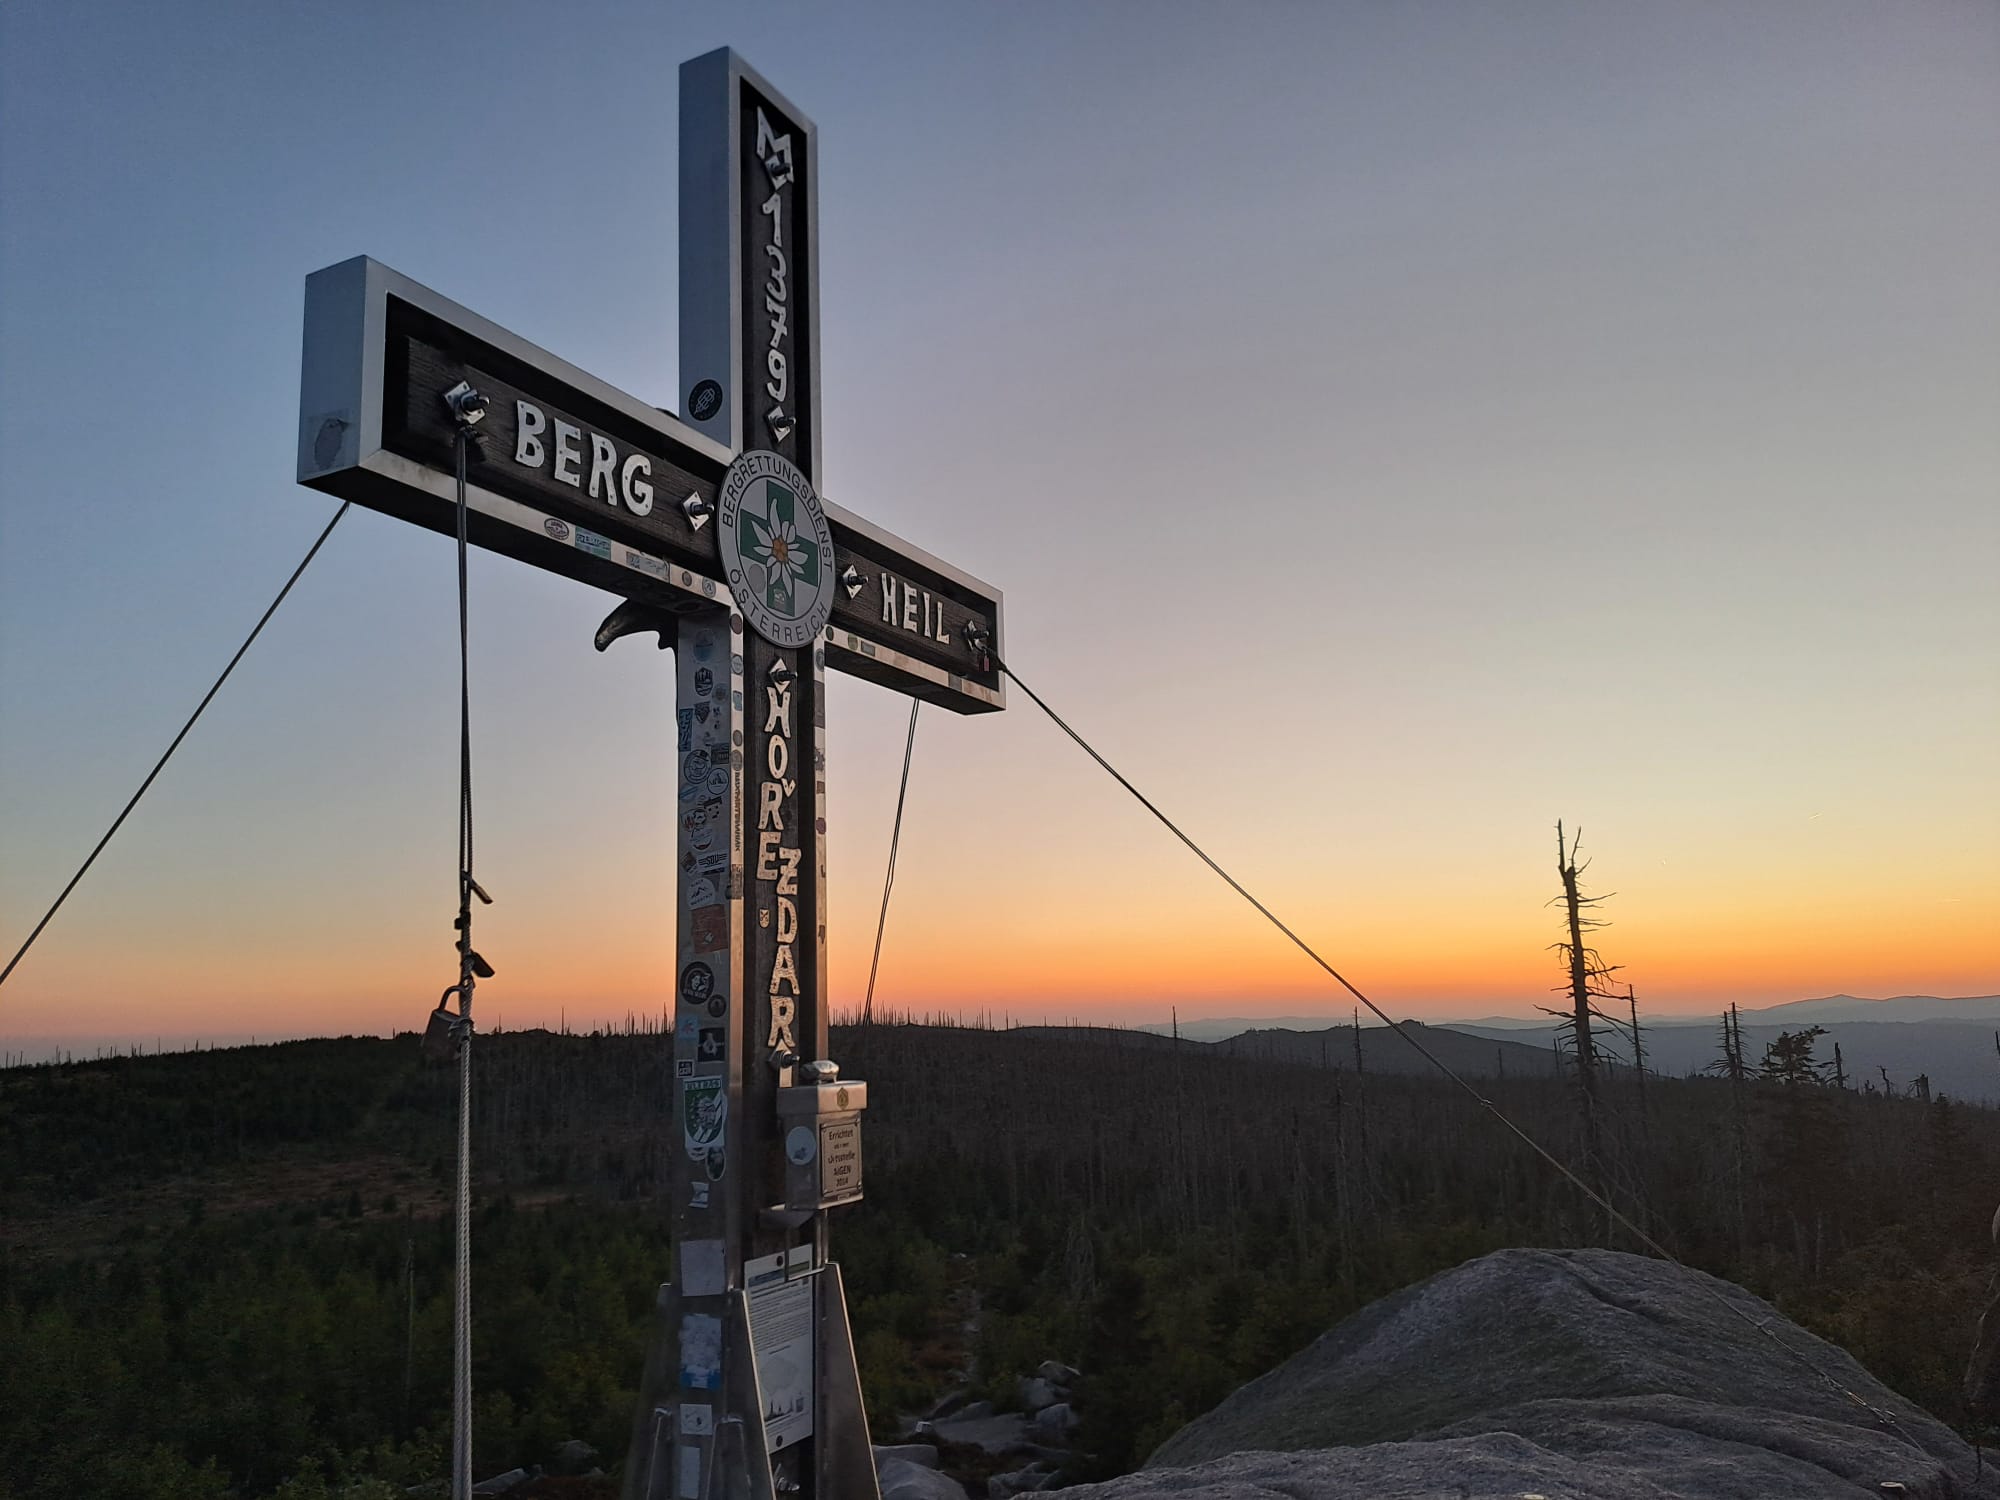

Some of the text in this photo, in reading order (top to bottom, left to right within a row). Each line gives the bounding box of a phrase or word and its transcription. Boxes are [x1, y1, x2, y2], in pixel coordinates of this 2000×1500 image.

[762, 193, 788, 402] 1379
[515, 399, 654, 517] BERG
[722, 455, 833, 573] BERGRETTUNGSDIENST
[729, 568, 828, 643] ÖSTERREICH
[881, 572, 950, 645] HEIL
[756, 686, 802, 1048] HOŘE ZDAR
[828, 1129, 854, 1141] Errichtet
